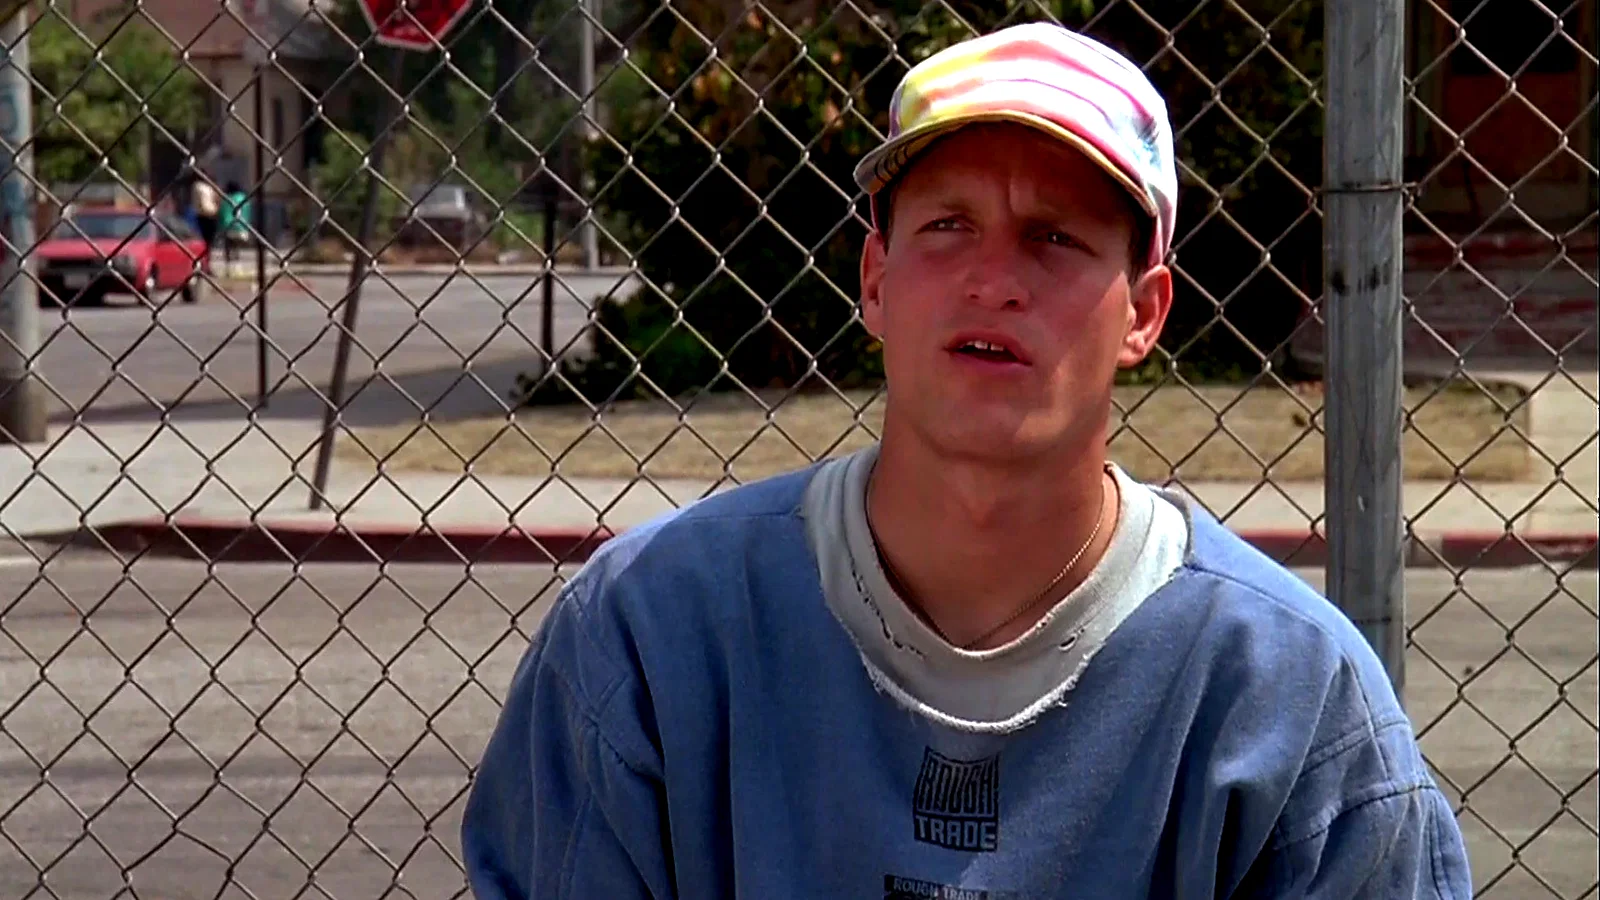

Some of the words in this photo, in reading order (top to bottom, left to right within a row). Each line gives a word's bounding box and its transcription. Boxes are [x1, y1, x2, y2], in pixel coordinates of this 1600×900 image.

[916, 755, 995, 815] ROUGH
[915, 816, 996, 849] TRADE
[893, 877, 939, 897] ROUGH
